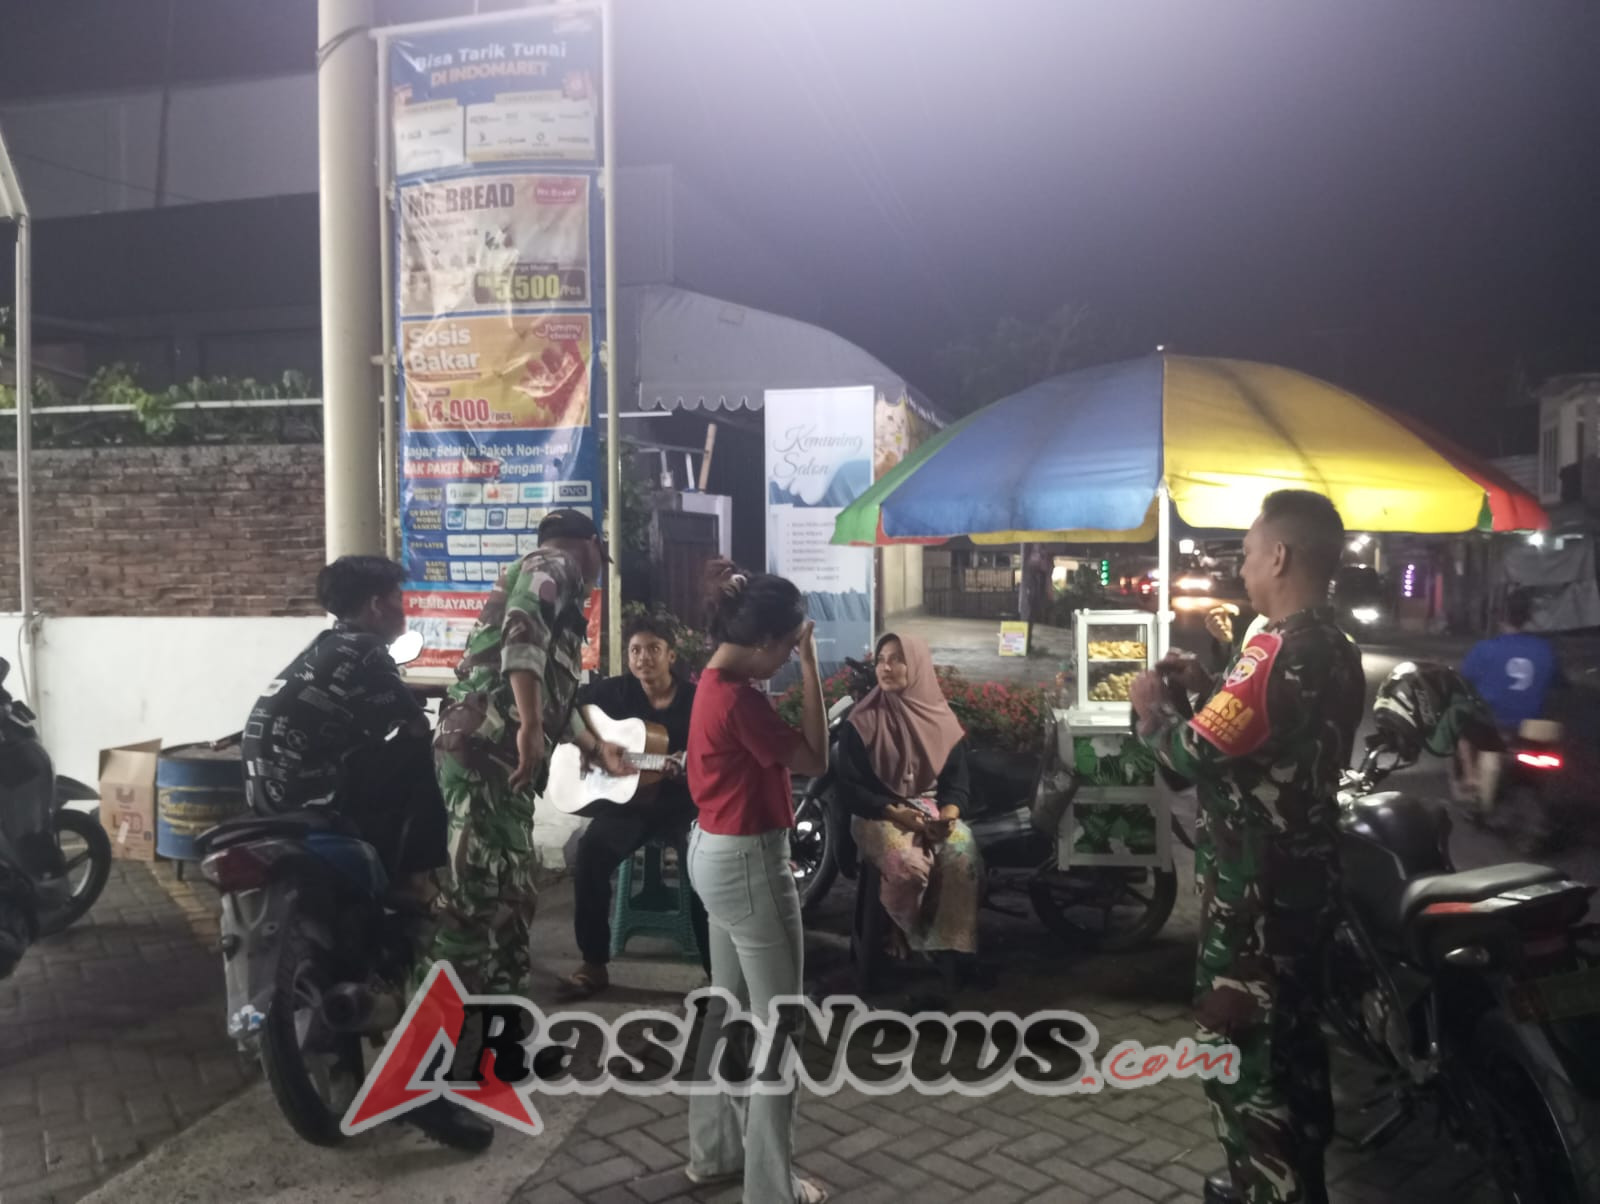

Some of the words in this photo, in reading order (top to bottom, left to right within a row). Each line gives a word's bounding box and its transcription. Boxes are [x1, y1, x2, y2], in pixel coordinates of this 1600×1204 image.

[415, 53, 452, 70] Bisa
[458, 43, 505, 62] Tarik
[511, 41, 567, 57] Tunai
[448, 61, 550, 82] INDOMARET
[446, 183, 515, 213] BREAD
[409, 324, 471, 349] Sosis
[411, 351, 480, 373] Bakar
[427, 461, 459, 475] PAKEK
[500, 463, 544, 477] dengan
[774, 452, 829, 478] Salon
[561, 486, 587, 497] OVO
